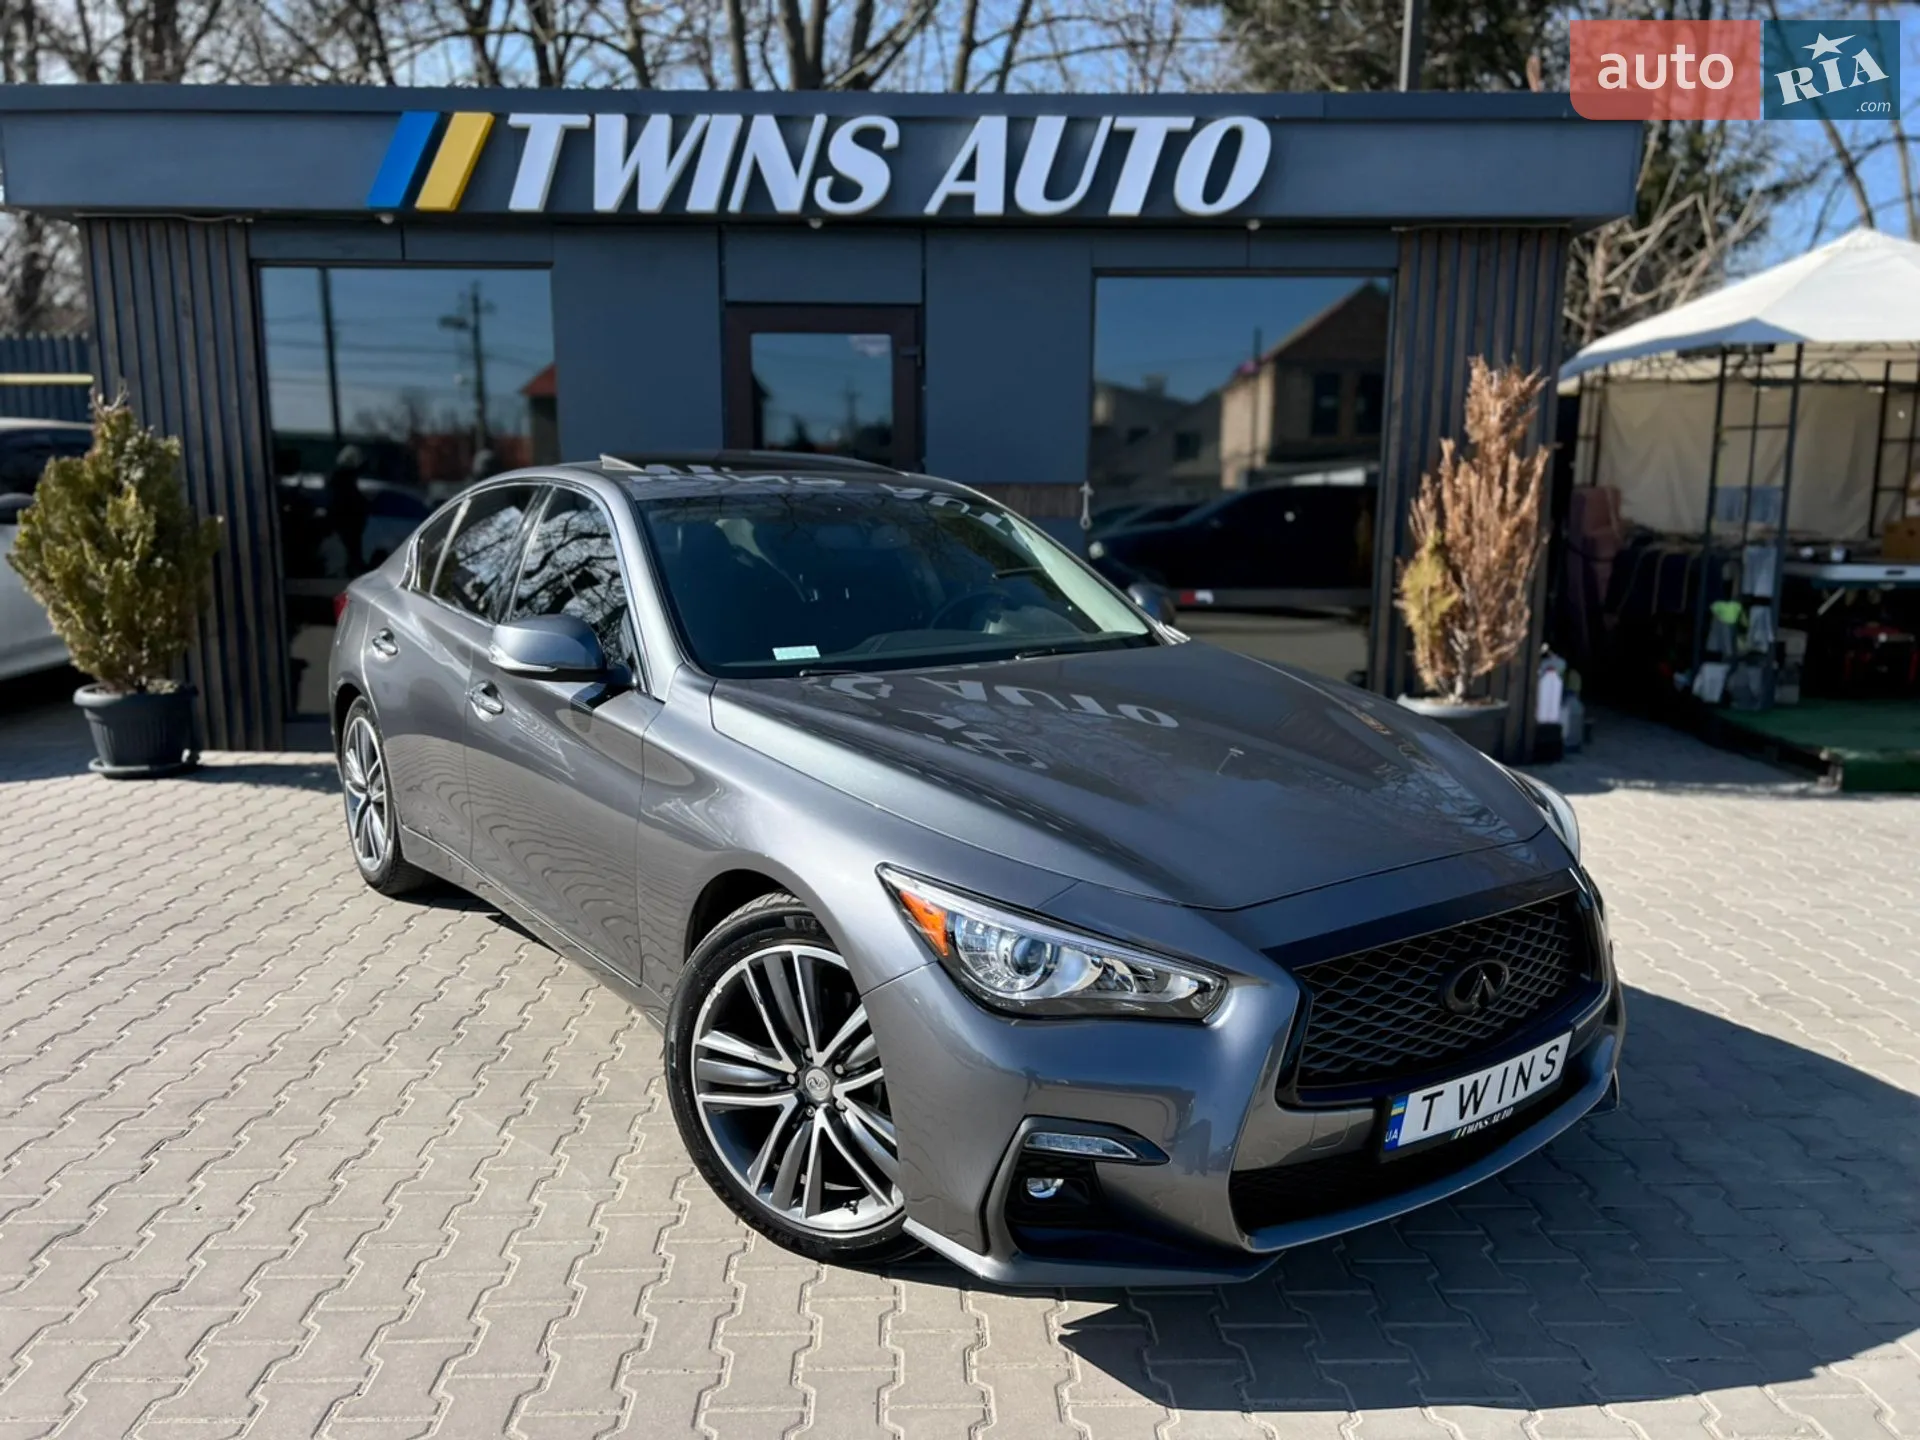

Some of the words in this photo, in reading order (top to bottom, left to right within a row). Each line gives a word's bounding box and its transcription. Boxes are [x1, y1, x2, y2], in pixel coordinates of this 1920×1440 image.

[506, 112, 901, 216] TWINS
[923, 113, 1273, 218] AUTO
[1420, 1043, 1560, 1132] TWINS
[1384, 1127, 1399, 1143] UA
